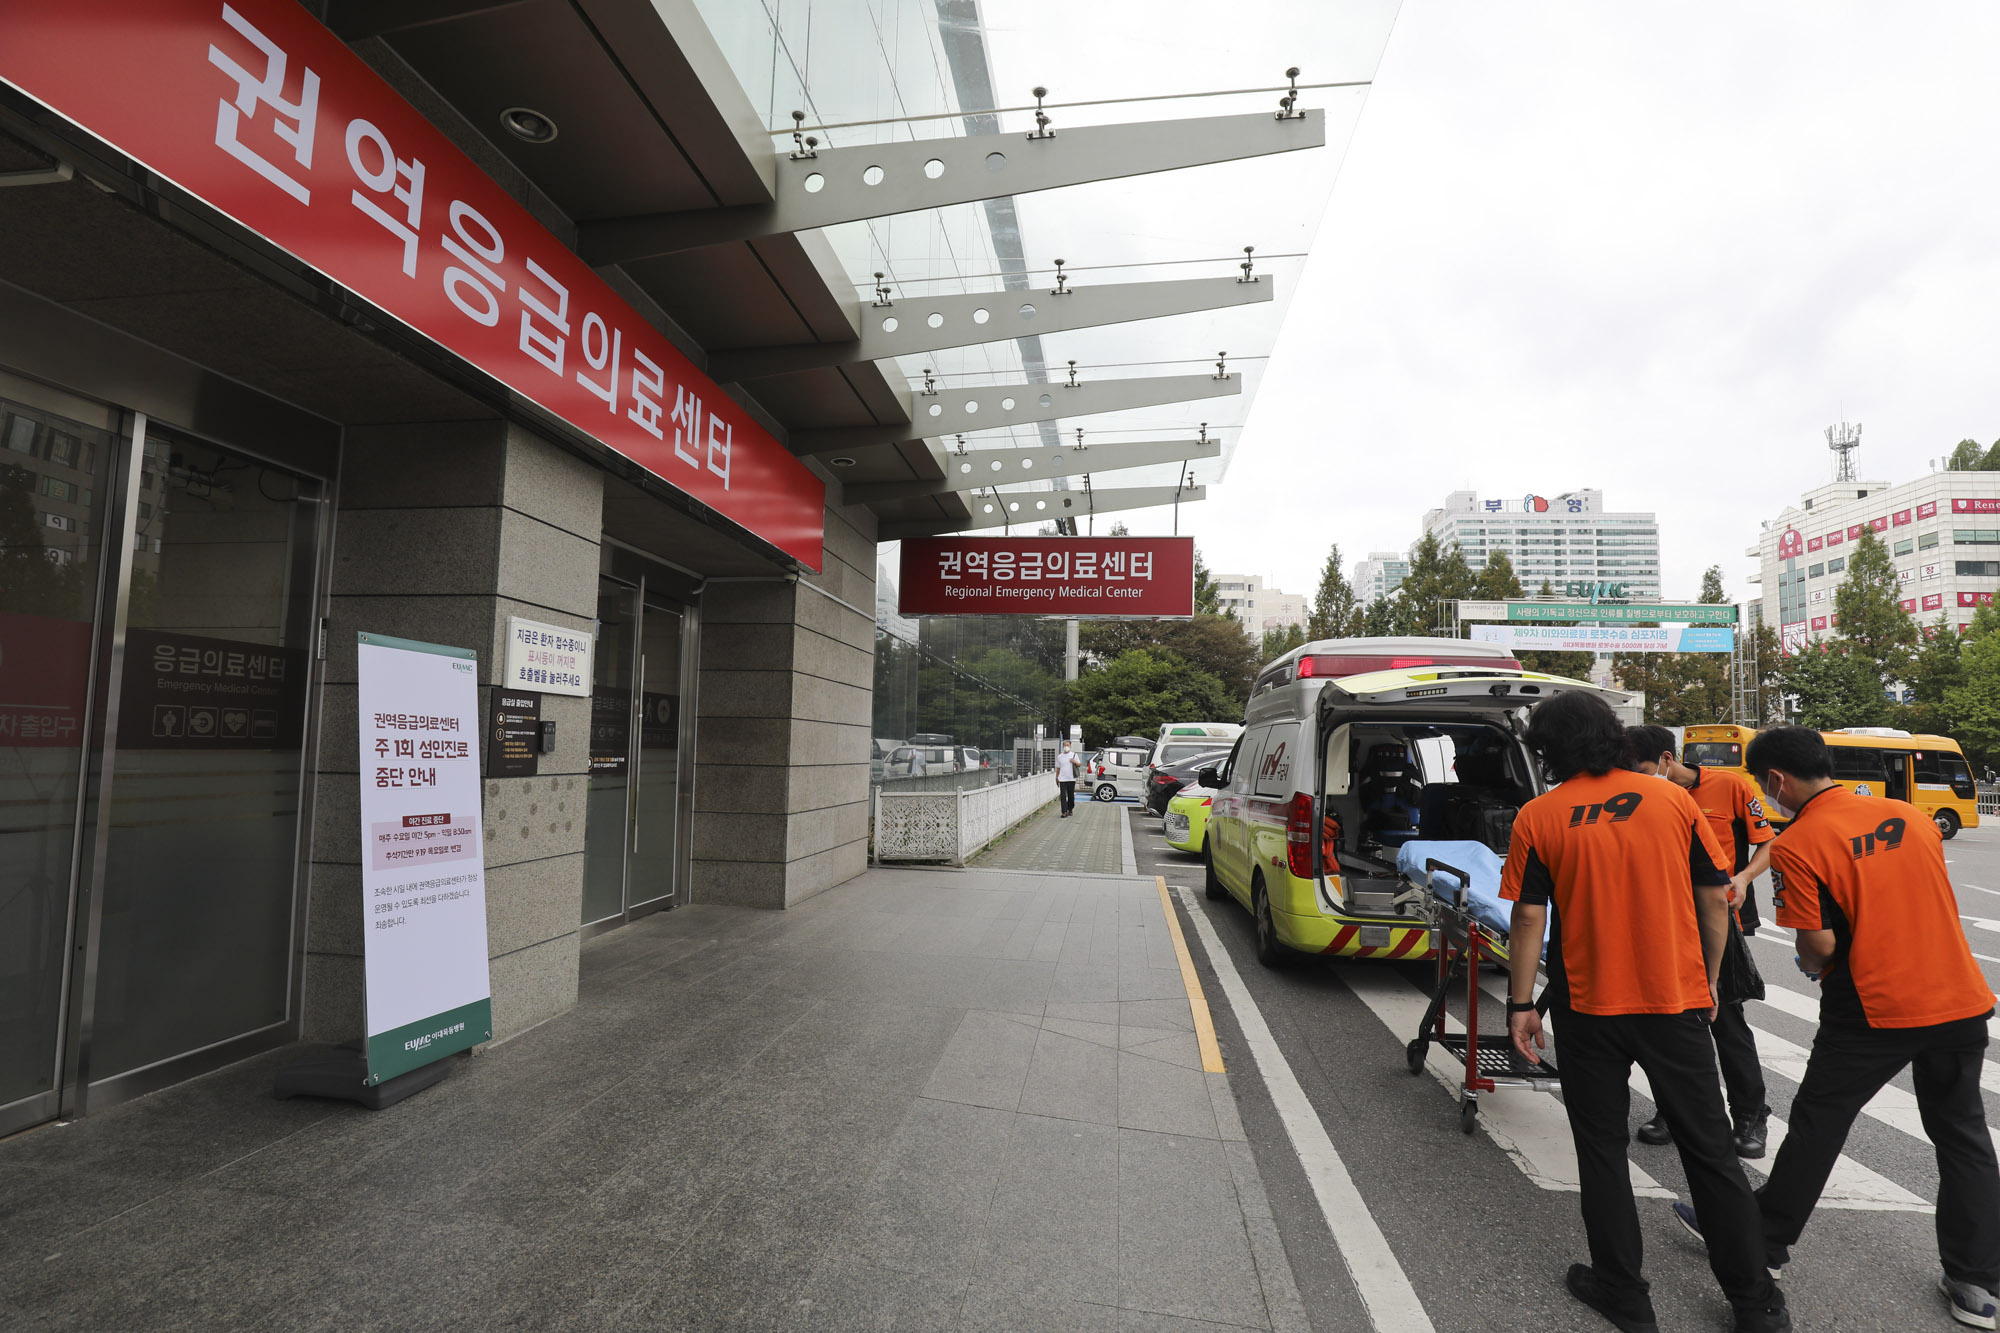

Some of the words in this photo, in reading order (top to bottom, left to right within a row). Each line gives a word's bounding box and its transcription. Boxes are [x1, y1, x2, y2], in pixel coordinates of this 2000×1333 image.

[208, 2, 732, 490] 권역응급의료센터
[1485, 499, 1502, 512] 부
[1566, 499, 1582, 512] 영
[938, 551, 1153, 580] 권역응급의료센터
[945, 585, 992, 598] Regional
[996, 586, 1056, 600] Emergency
[1058, 586, 1102, 598] Medical
[1106, 586, 1143, 598] Center
[1516, 608, 1539, 617] 사랑의
[1542, 608, 1565, 617] 기독교
[1567, 608, 1598, 618] 정신으로
[1601, 609, 1623, 618] 인류를
[1626, 609, 1672, 618] 질병으로부터
[1675, 610, 1705, 619] 보호하고
[1708, 610, 1730, 620] 구한다
[518, 629, 538, 645] 지금은
[541, 632, 554, 648] 환자
[556, 636, 586, 654] 접수중이니
[1514, 628, 1538, 638] 제9차
[1542, 629, 1587, 638] 이화의료원
[1590, 630, 1628, 639] 로봇수술
[1631, 630, 1668, 639] 심포지엄
[153, 644, 286, 682] 응급의료센터
[528, 650, 555, 667] 표시등이
[156, 678, 212, 694] Emergency
[214, 682, 250, 694] Medical
[519, 666, 547, 684] 호출벨을
[549, 671, 580, 687] 눌러주세요
[20, 715, 76, 738] 출입구
[374, 713, 459, 732] 권역응급의료센터
[375, 738, 390, 758] 주
[394, 739, 414, 758] 1회
[419, 740, 469, 758] 성인진료
[1260, 742, 1286, 780] 119
[376, 768, 404, 787] 중단
[408, 768, 436, 786] 안내
[1568, 792, 1643, 829] 119
[379, 834, 391, 842] 매주
[393, 832, 410, 841] 수요일
[424, 831, 436, 840] 5pm
[1848, 818, 1906, 860] 119
[386, 850, 414, 860] 추석기간만
[428, 846, 449, 855] 목요일로
[451, 844, 462, 852] 변경
[375, 888, 392, 897] 조속한
[394, 884, 405, 894] 시일
[406, 882, 418, 892] 내에
[419, 875, 466, 890] 권역응급의료센터가
[468, 874, 478, 883] 정상
[375, 903, 392, 914] 운영될
[394, 902, 400, 910] 수
[401, 898, 418, 908] 있도록
[420, 895, 436, 905] 최선을
[376, 916, 406, 930] 죄송합니다.
[432, 1022, 464, 1040] 이대목동병원
